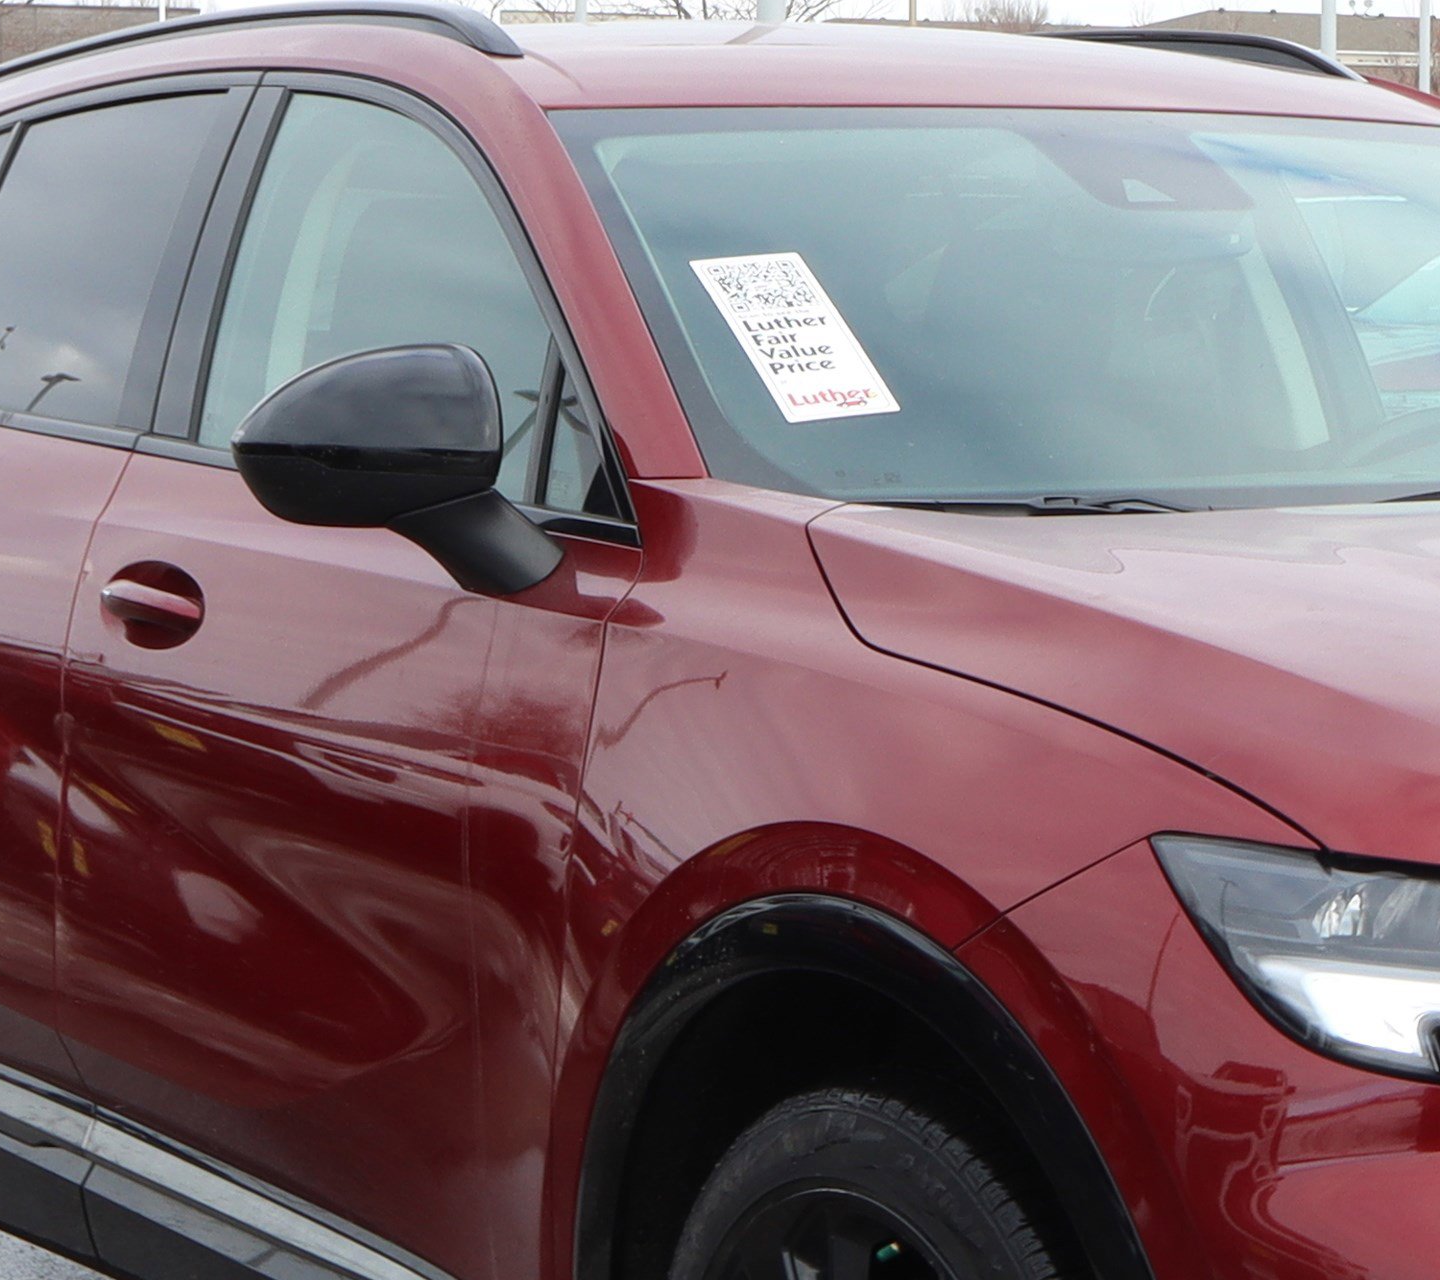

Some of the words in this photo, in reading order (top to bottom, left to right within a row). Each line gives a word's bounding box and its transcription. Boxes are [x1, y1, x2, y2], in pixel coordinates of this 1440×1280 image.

[743, 316, 827, 332] Luther
[751, 332, 797, 347] Fair
[759, 345, 835, 361] Value
[768, 359, 837, 375] Price
[787, 388, 872, 407] Luther
